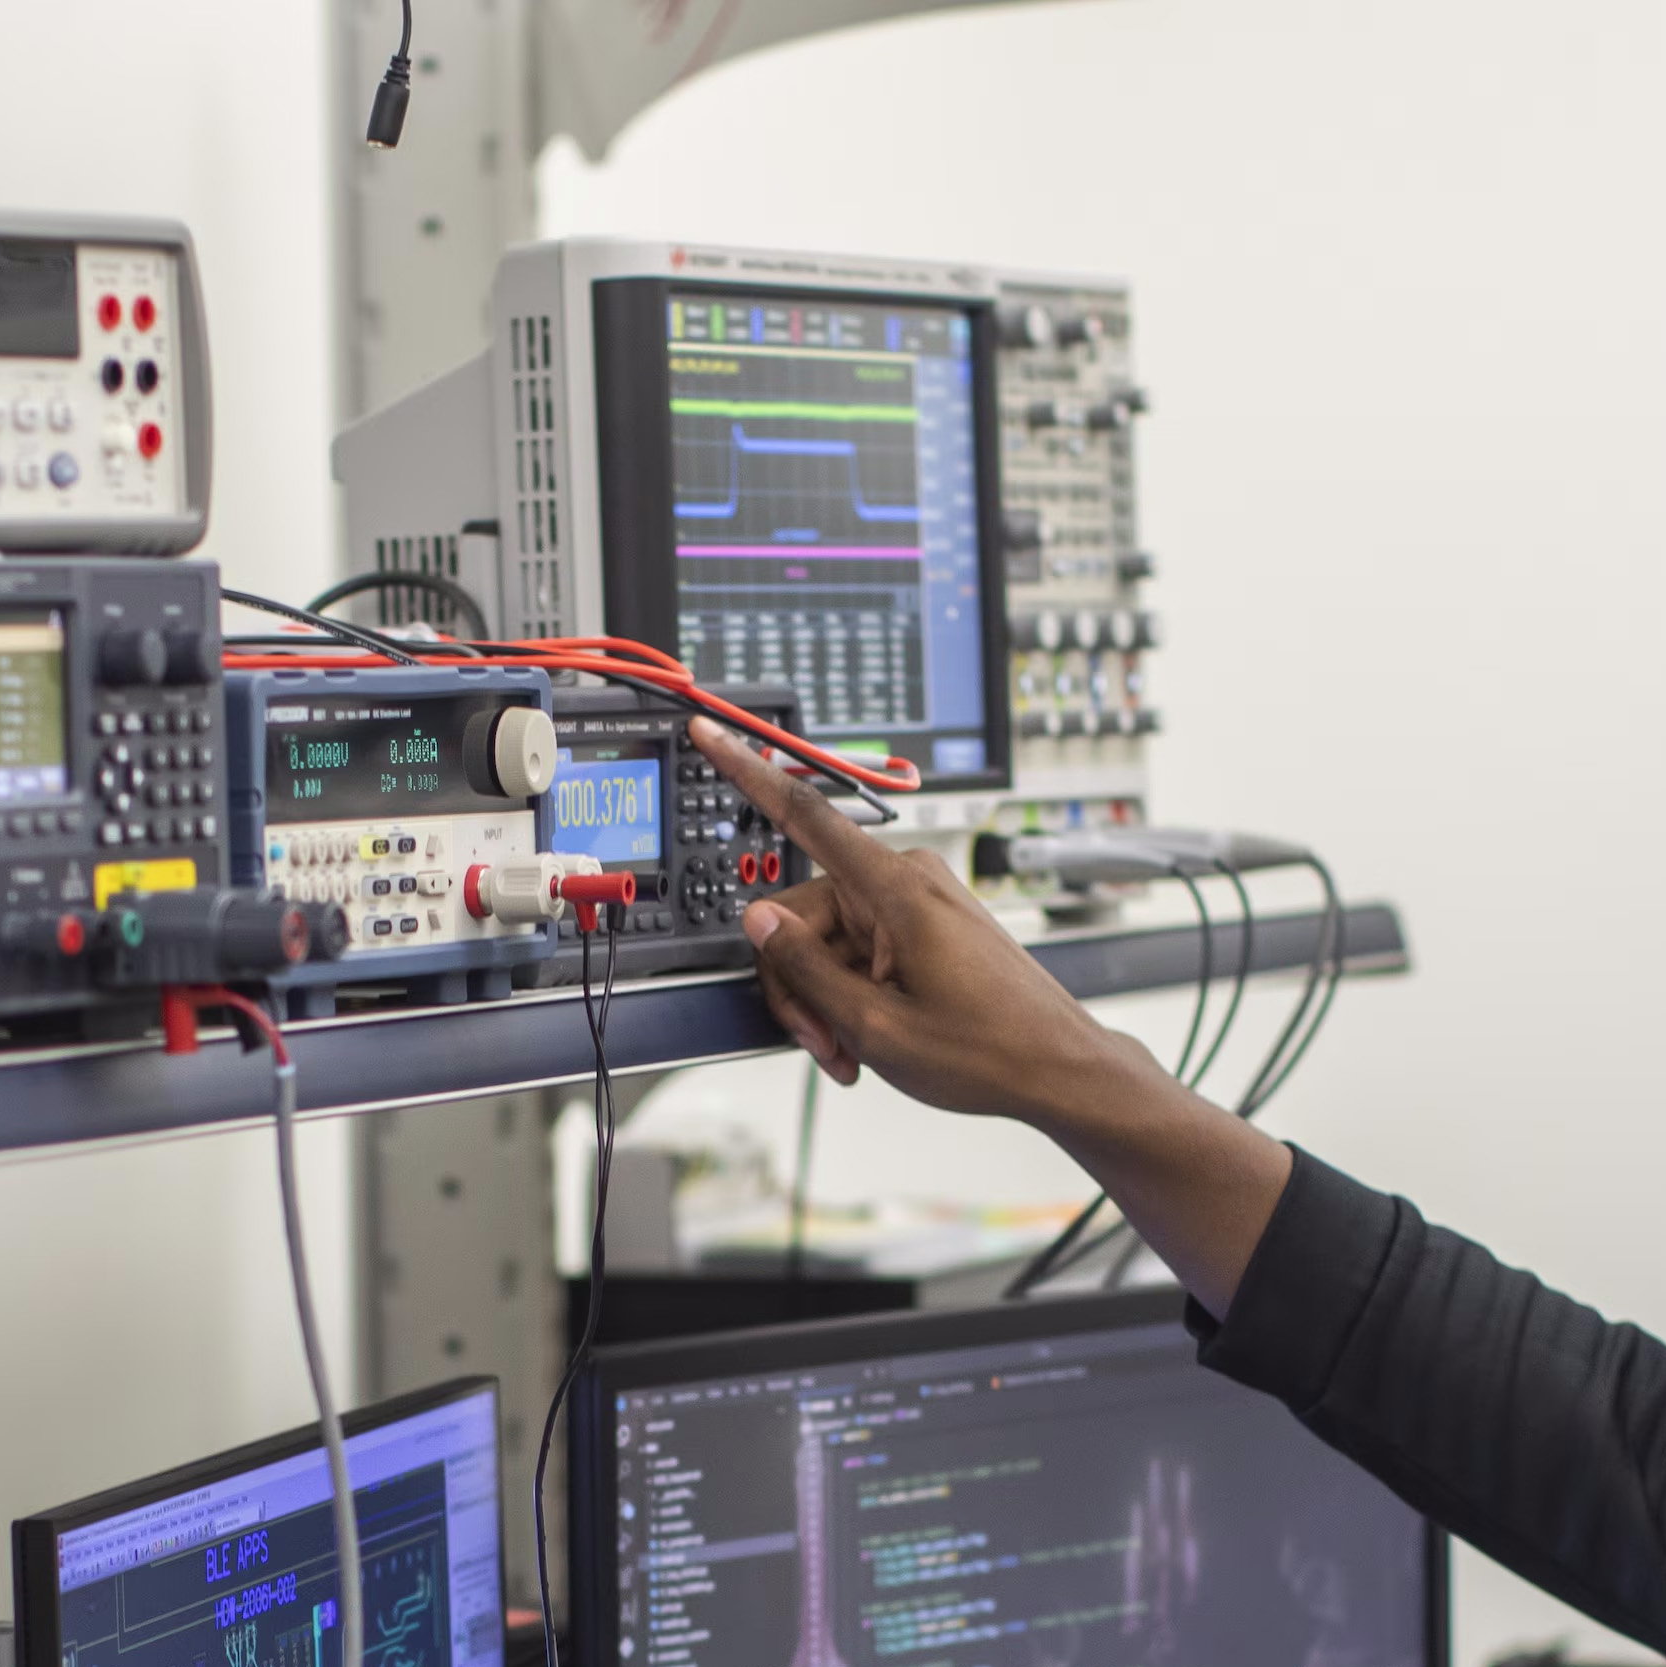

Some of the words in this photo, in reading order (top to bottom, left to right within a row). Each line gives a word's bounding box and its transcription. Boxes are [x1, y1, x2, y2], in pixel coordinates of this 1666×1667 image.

[290, 742, 349, 770] 0.0000V
[390, 737, 438, 764] 0.000A
[402, 839, 412, 851] CV
[484, 827, 503, 841] INPUT
[206, 1541, 232, 1583] BLE
[237, 1529, 269, 1573] APPS
